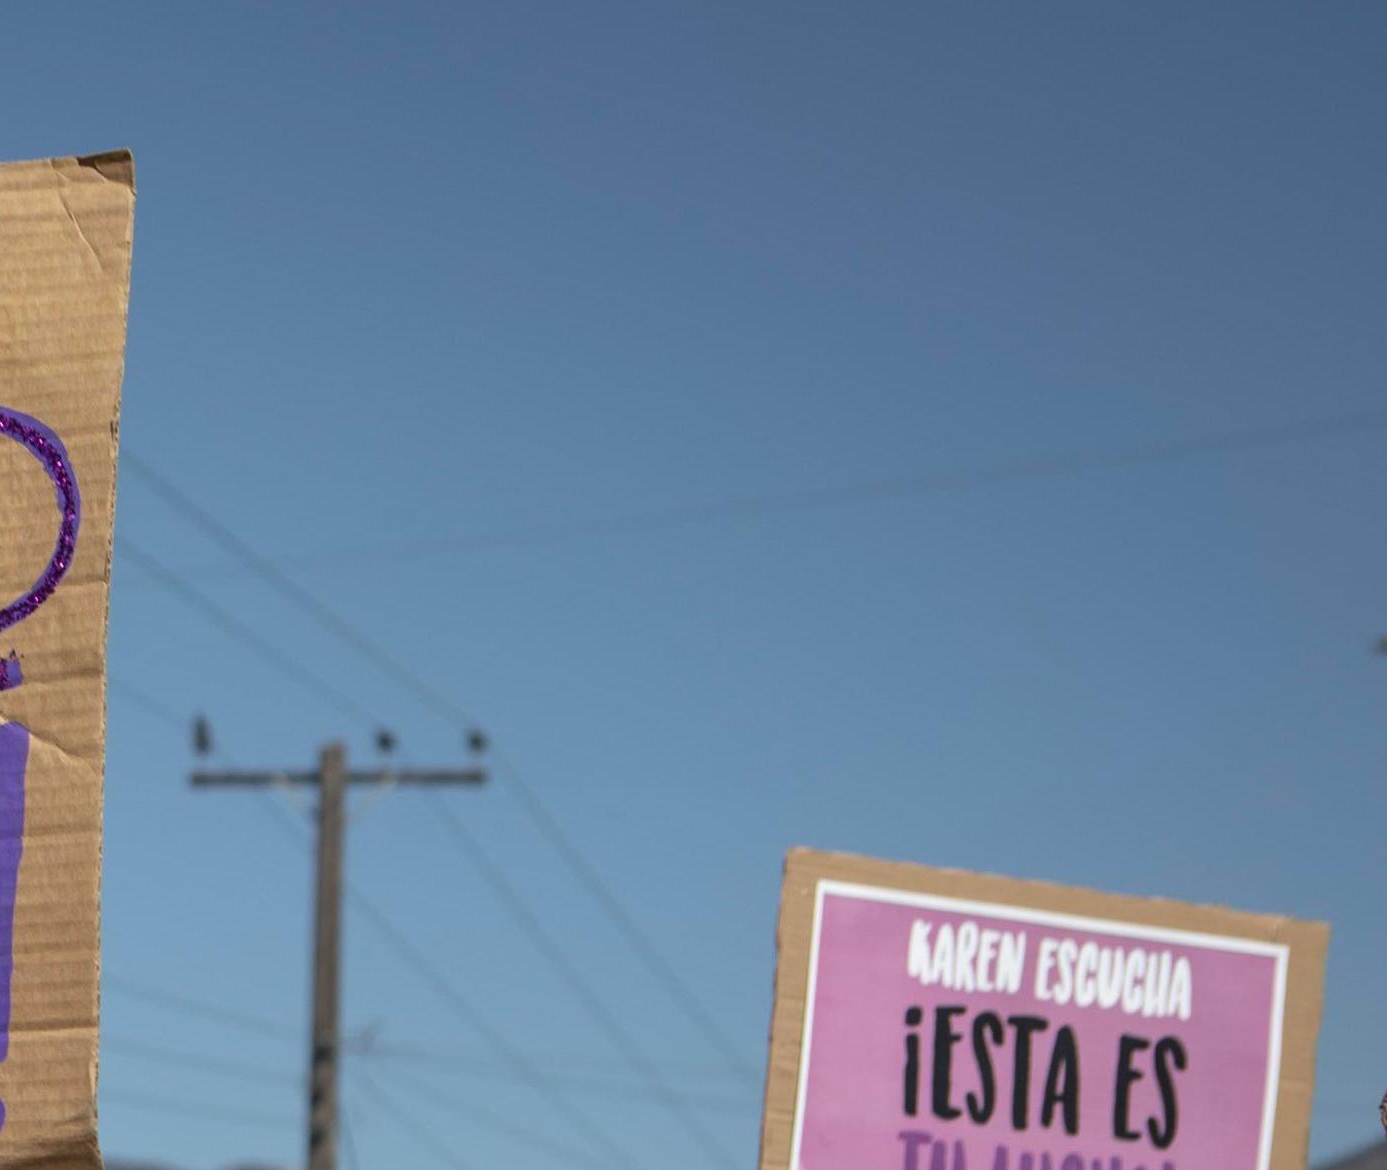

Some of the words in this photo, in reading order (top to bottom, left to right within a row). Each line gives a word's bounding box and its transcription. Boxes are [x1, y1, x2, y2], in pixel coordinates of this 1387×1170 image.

[907, 919, 1026, 994] KAREN
[1034, 937, 1193, 1021] ESCUCHA
[902, 1005, 1080, 1136] ¡ESTA
[1112, 1033, 1189, 1150] ES
